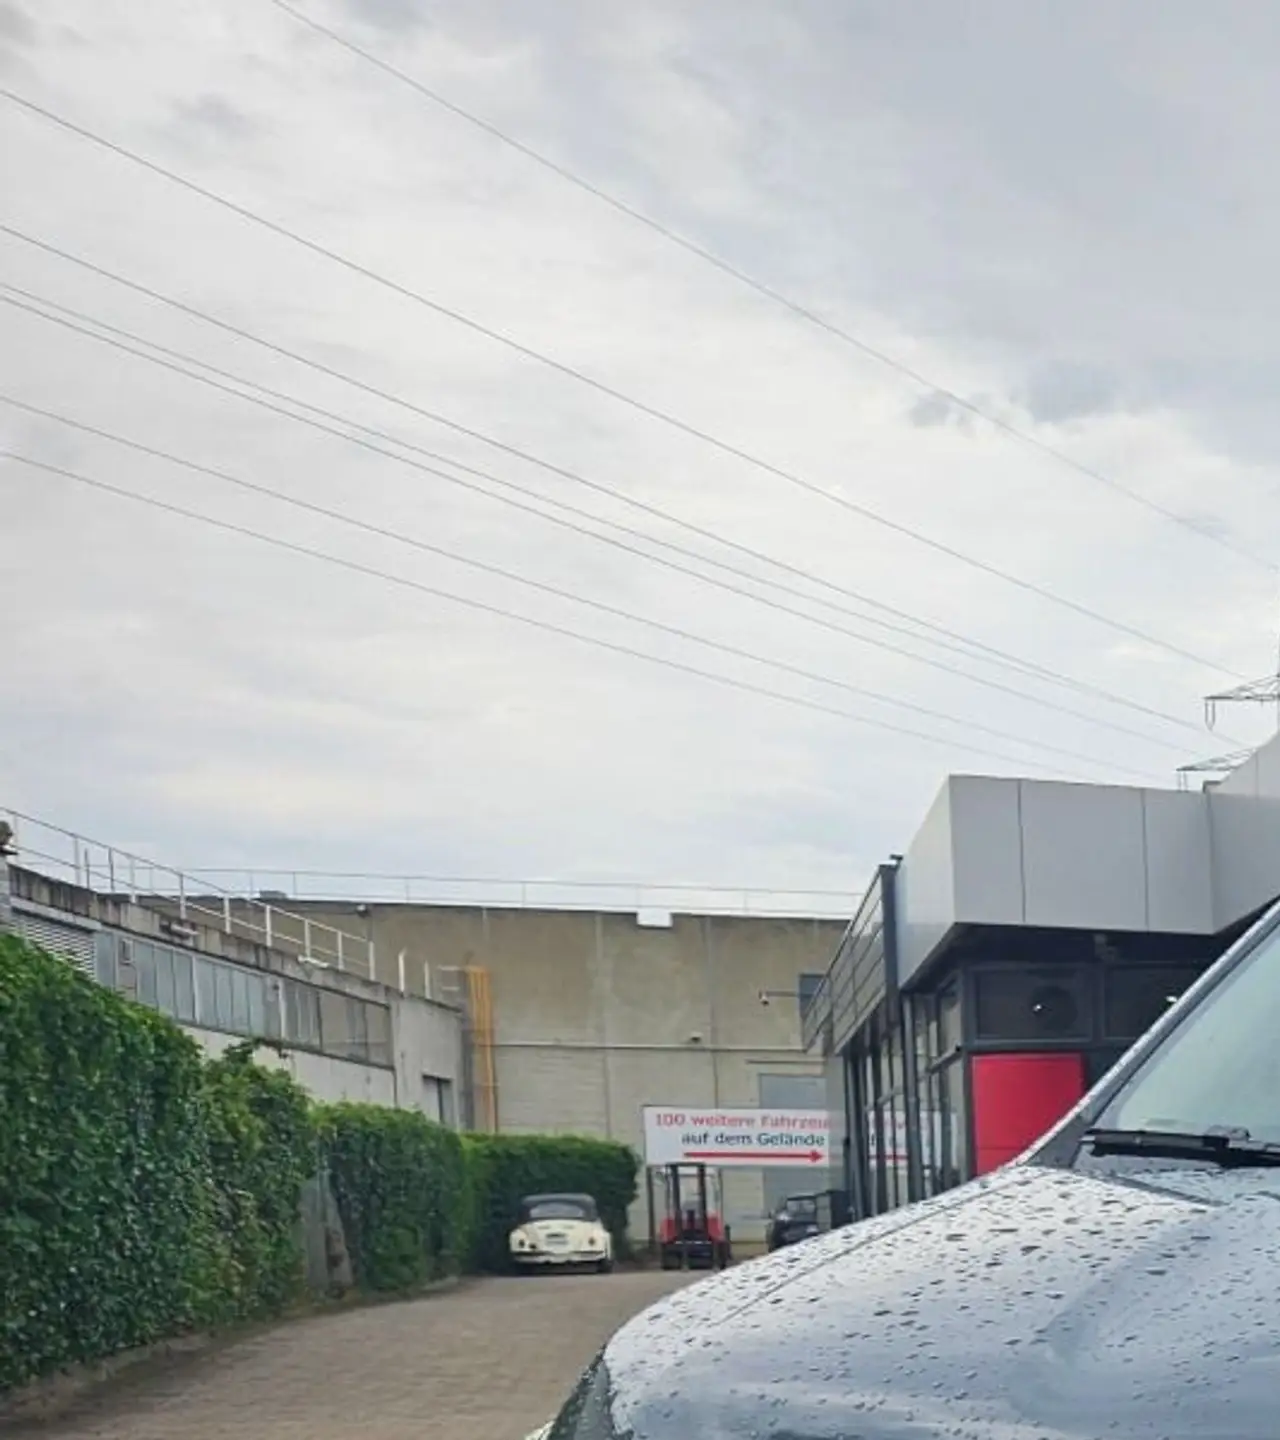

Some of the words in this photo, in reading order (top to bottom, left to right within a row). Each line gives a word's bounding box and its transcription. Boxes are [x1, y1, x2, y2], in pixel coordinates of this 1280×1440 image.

[656, 1113, 686, 1127] 100
[692, 1114, 755, 1129] weitere
[761, 1113, 832, 1131] Fahrzeu
[682, 1132, 708, 1145] auf
[715, 1132, 752, 1146] dem
[758, 1131, 825, 1147] Gelände
